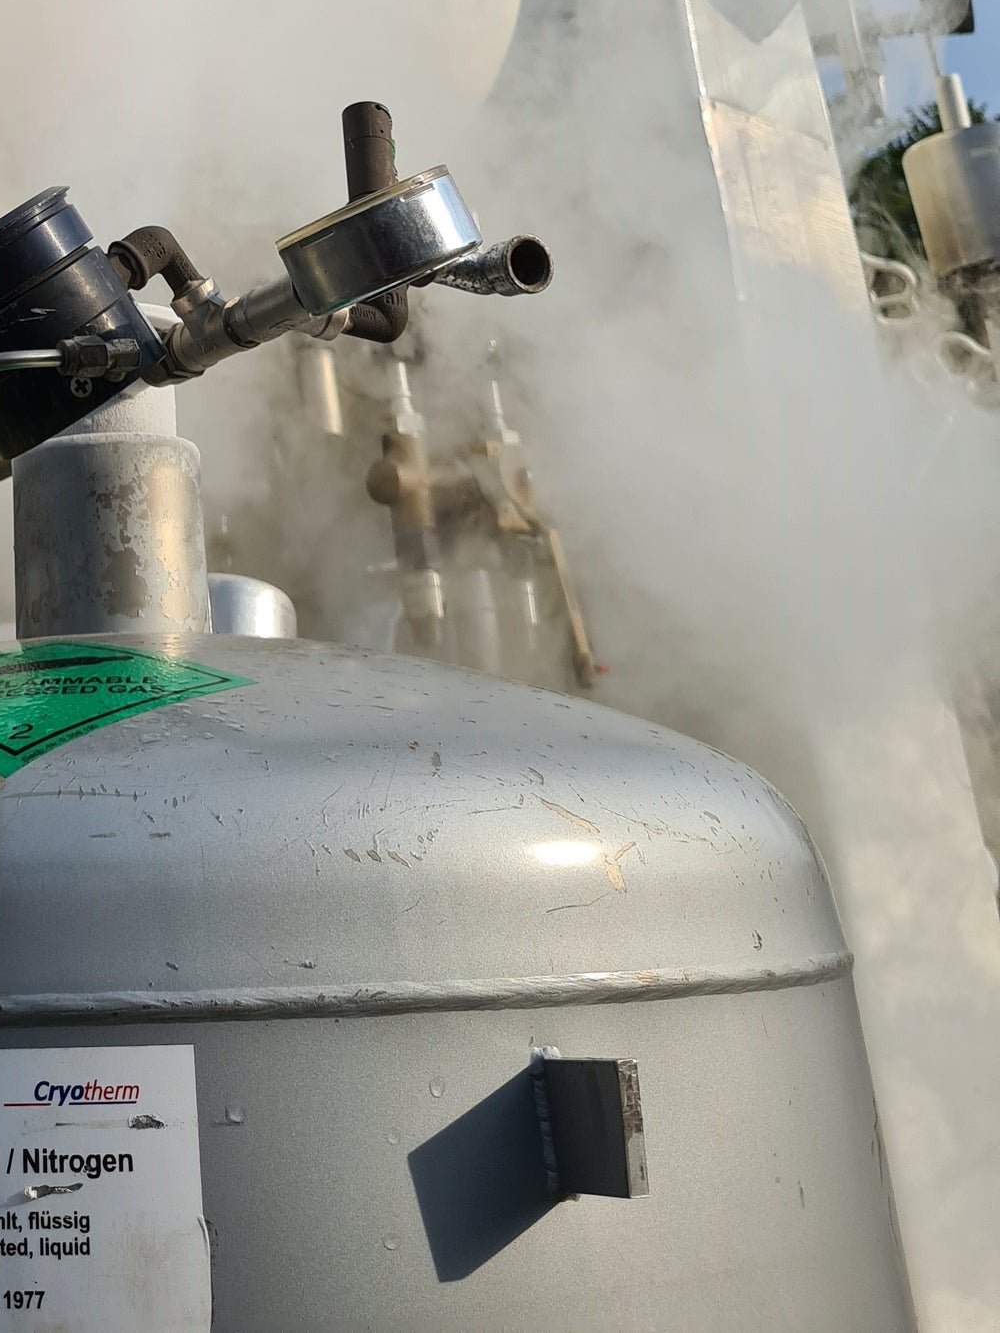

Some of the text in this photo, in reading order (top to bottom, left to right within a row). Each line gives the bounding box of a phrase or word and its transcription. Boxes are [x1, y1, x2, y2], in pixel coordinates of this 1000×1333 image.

[107, 684, 167, 696] GAS
[8, 723, 34, 740] 2
[33, 1079, 140, 1107] Cryotherm
[5, 1148, 15, 1175] /
[22, 1147, 134, 1180] Nitrogen
[28, 1211, 91, 1233] flüssig
[39, 1236, 91, 1260] liquid
[2, 1290, 45, 1309] 1977
